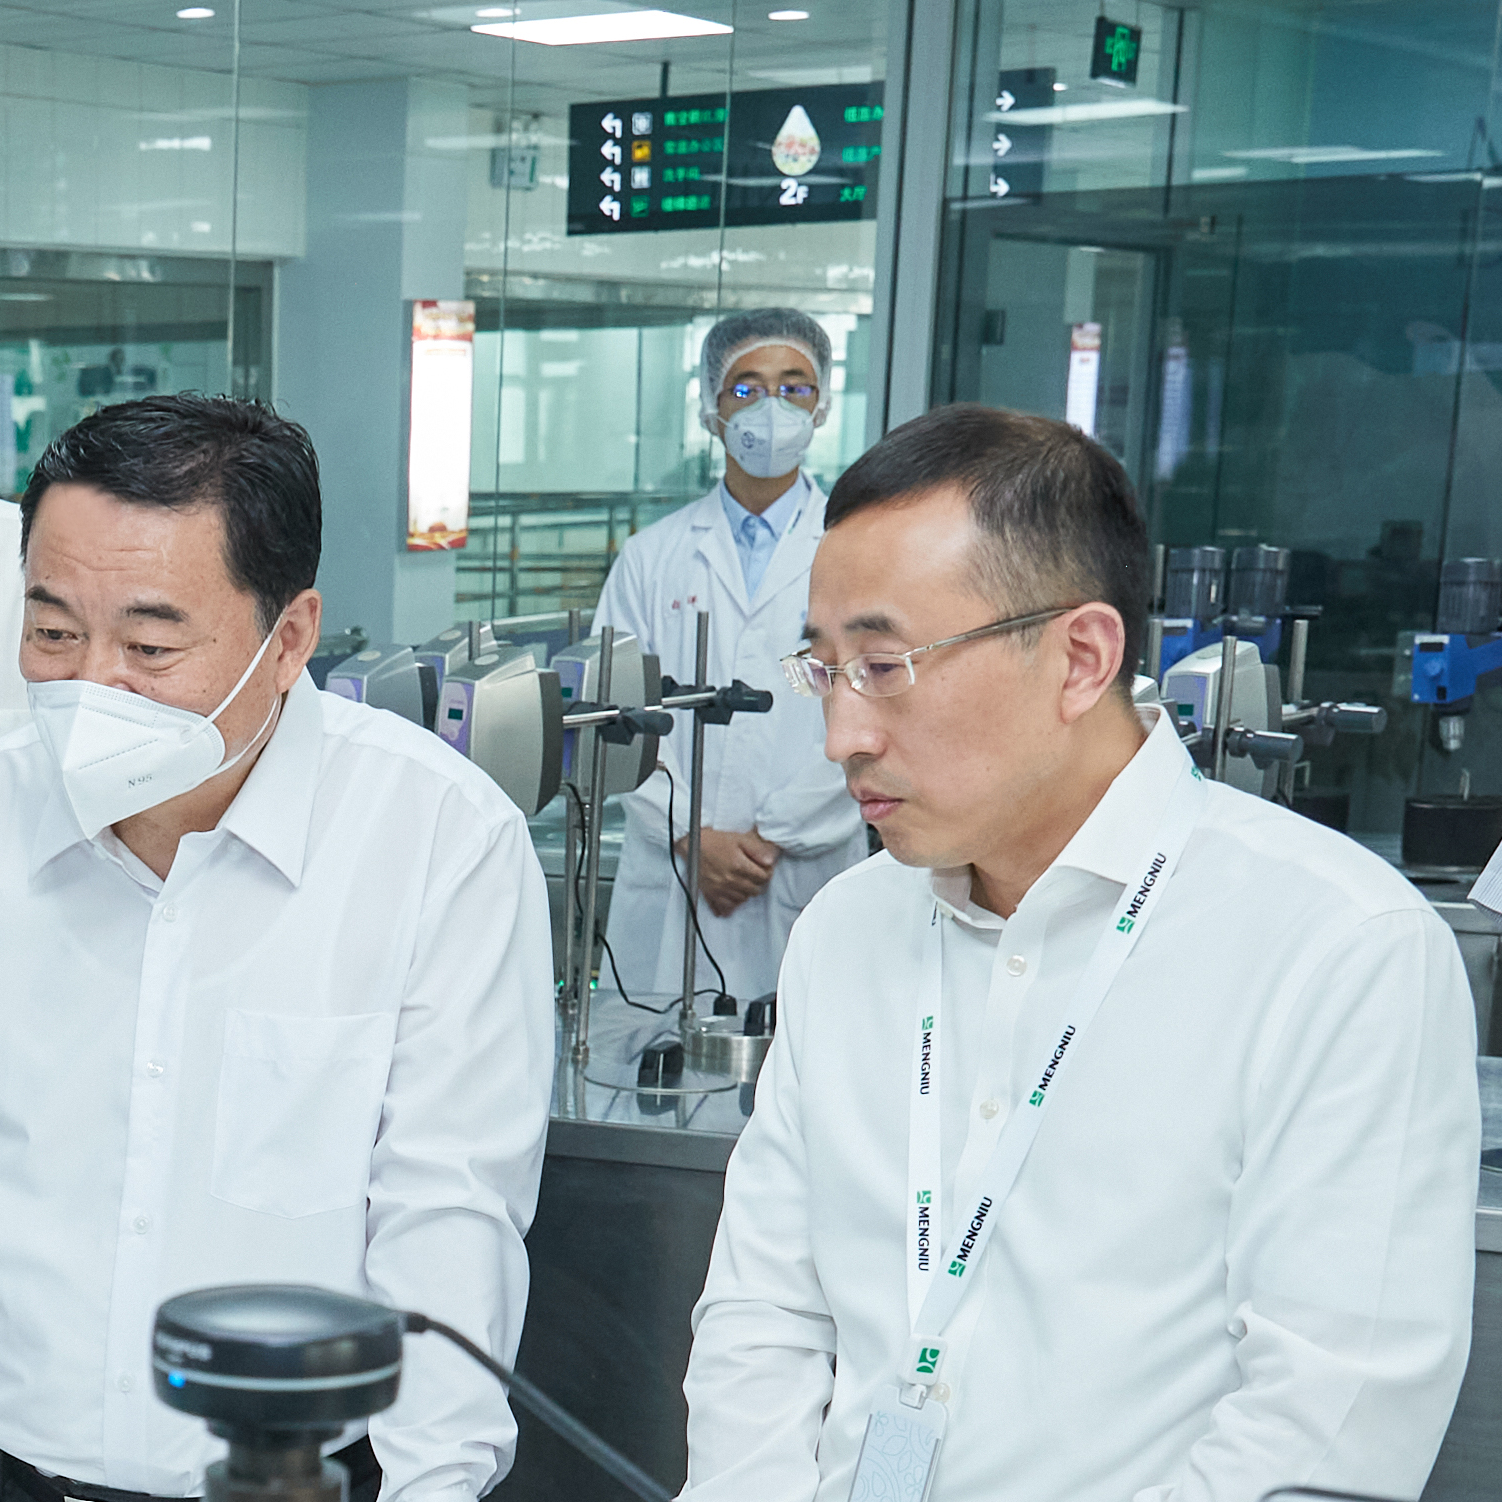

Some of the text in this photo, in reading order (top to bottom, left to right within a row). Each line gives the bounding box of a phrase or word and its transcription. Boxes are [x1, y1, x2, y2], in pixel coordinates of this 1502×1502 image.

[779, 177, 809, 206] 2F
[127, 774, 153, 788] N95
[1126, 852, 1167, 918] MENGNIU
[919, 1031, 932, 1095] MENGNIU
[1038, 1024, 1077, 1091] MENGNIU
[918, 1206, 930, 1271] MENGNIU
[956, 1196, 993, 1262] MENGNIU
